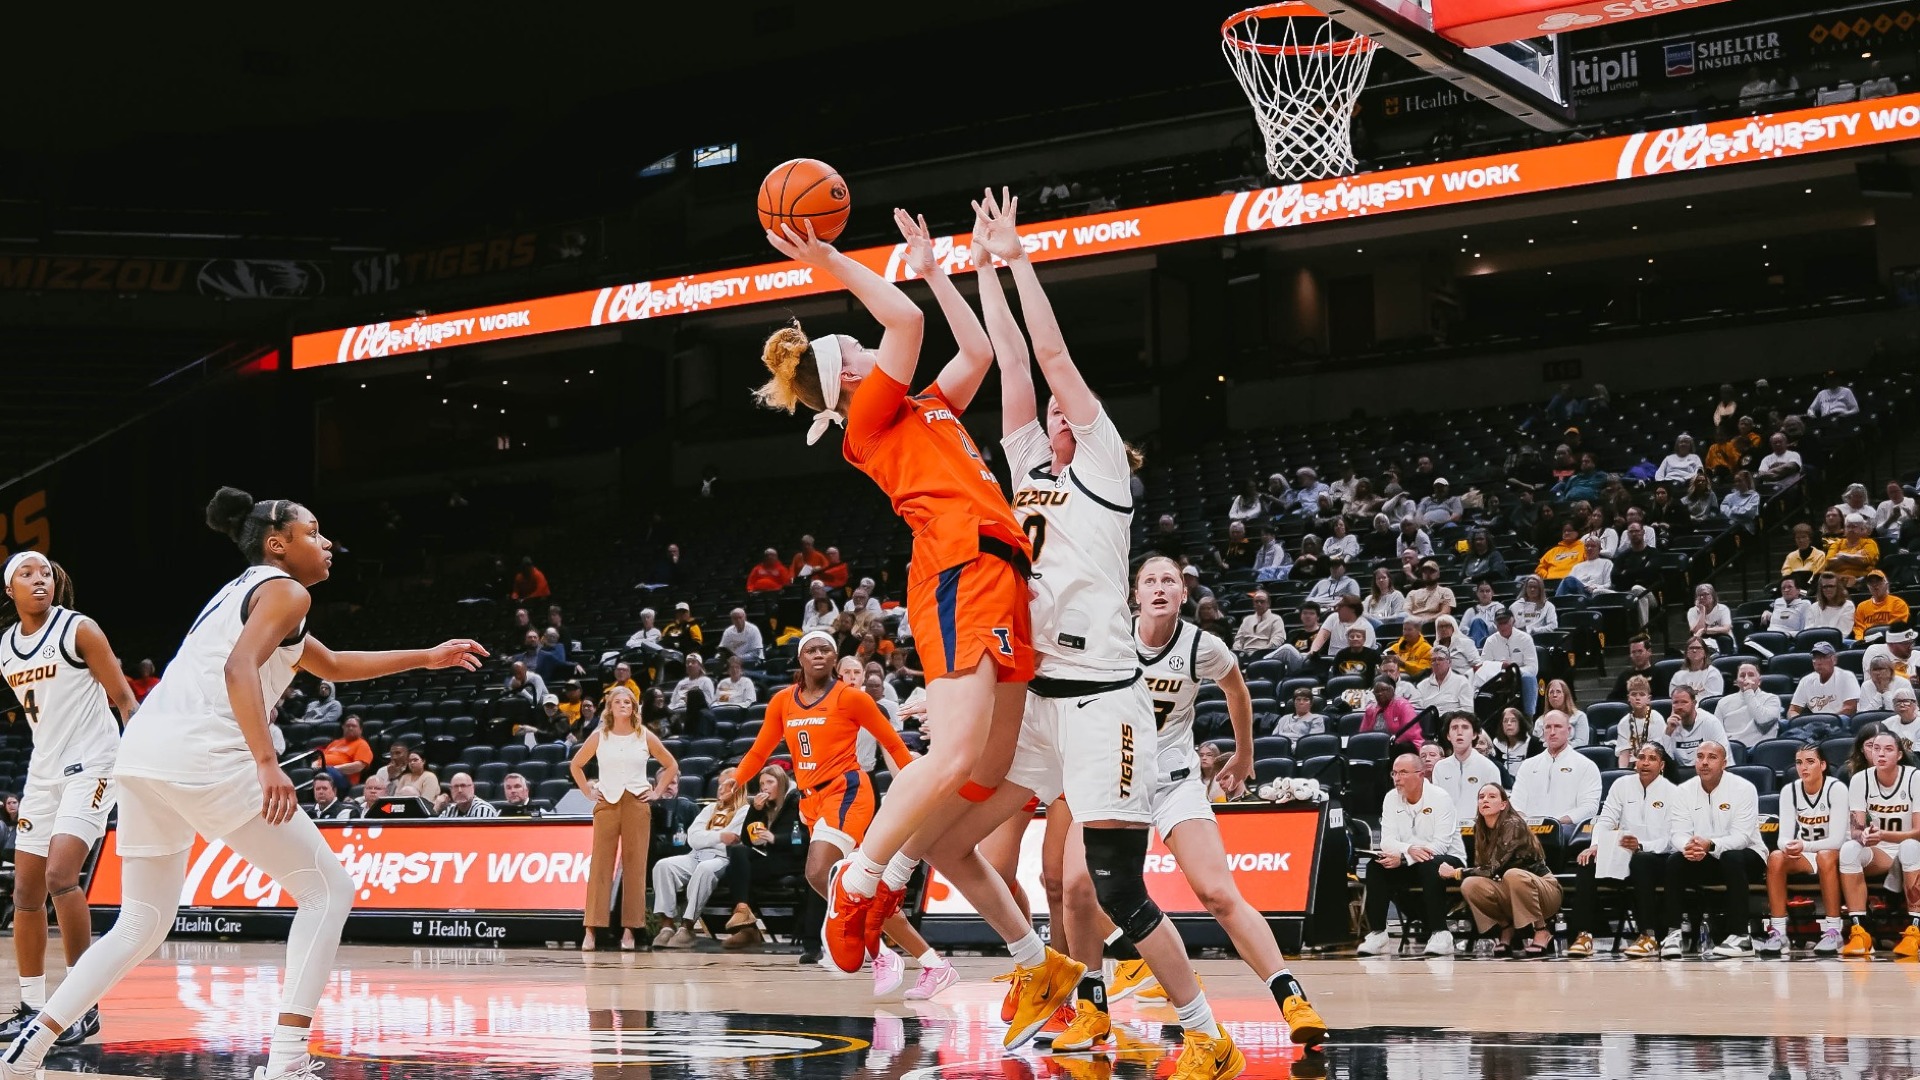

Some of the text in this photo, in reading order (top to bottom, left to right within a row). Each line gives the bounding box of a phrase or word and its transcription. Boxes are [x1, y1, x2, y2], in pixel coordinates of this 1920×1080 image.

[1603, 0, 1698, 18] Sta
[1698, 32, 1780, 58] SHELTER
[1699, 49, 1781, 70] INSURANCE
[1610, 79, 1638, 91] union
[1405, 90, 1458, 112] Health
[1442, 164, 1520, 192] WORK
[1072, 219, 1140, 246] WORK
[402, 233, 539, 286] TIGERS
[0, 256, 188, 292] MIZZOU
[754, 268, 813, 292] WORK
[479, 310, 530, 332] WORK
[1011, 490, 1070, 511] IZZOU
[0, 489, 51, 557] S
[23, 688, 40, 724] 4
[786, 717, 827, 727] FIGHTING
[798, 730, 812, 757] 8
[1119, 722, 1136, 800] TIGERS
[1868, 803, 1909, 813] MZZOU
[1800, 828, 1825, 842] 22
[1879, 818, 1903, 832] 10
[487, 851, 592, 884] WORK
[174, 916, 242, 933] Health Care
[428, 920, 472, 937] Health
[475, 921, 507, 937] Care
